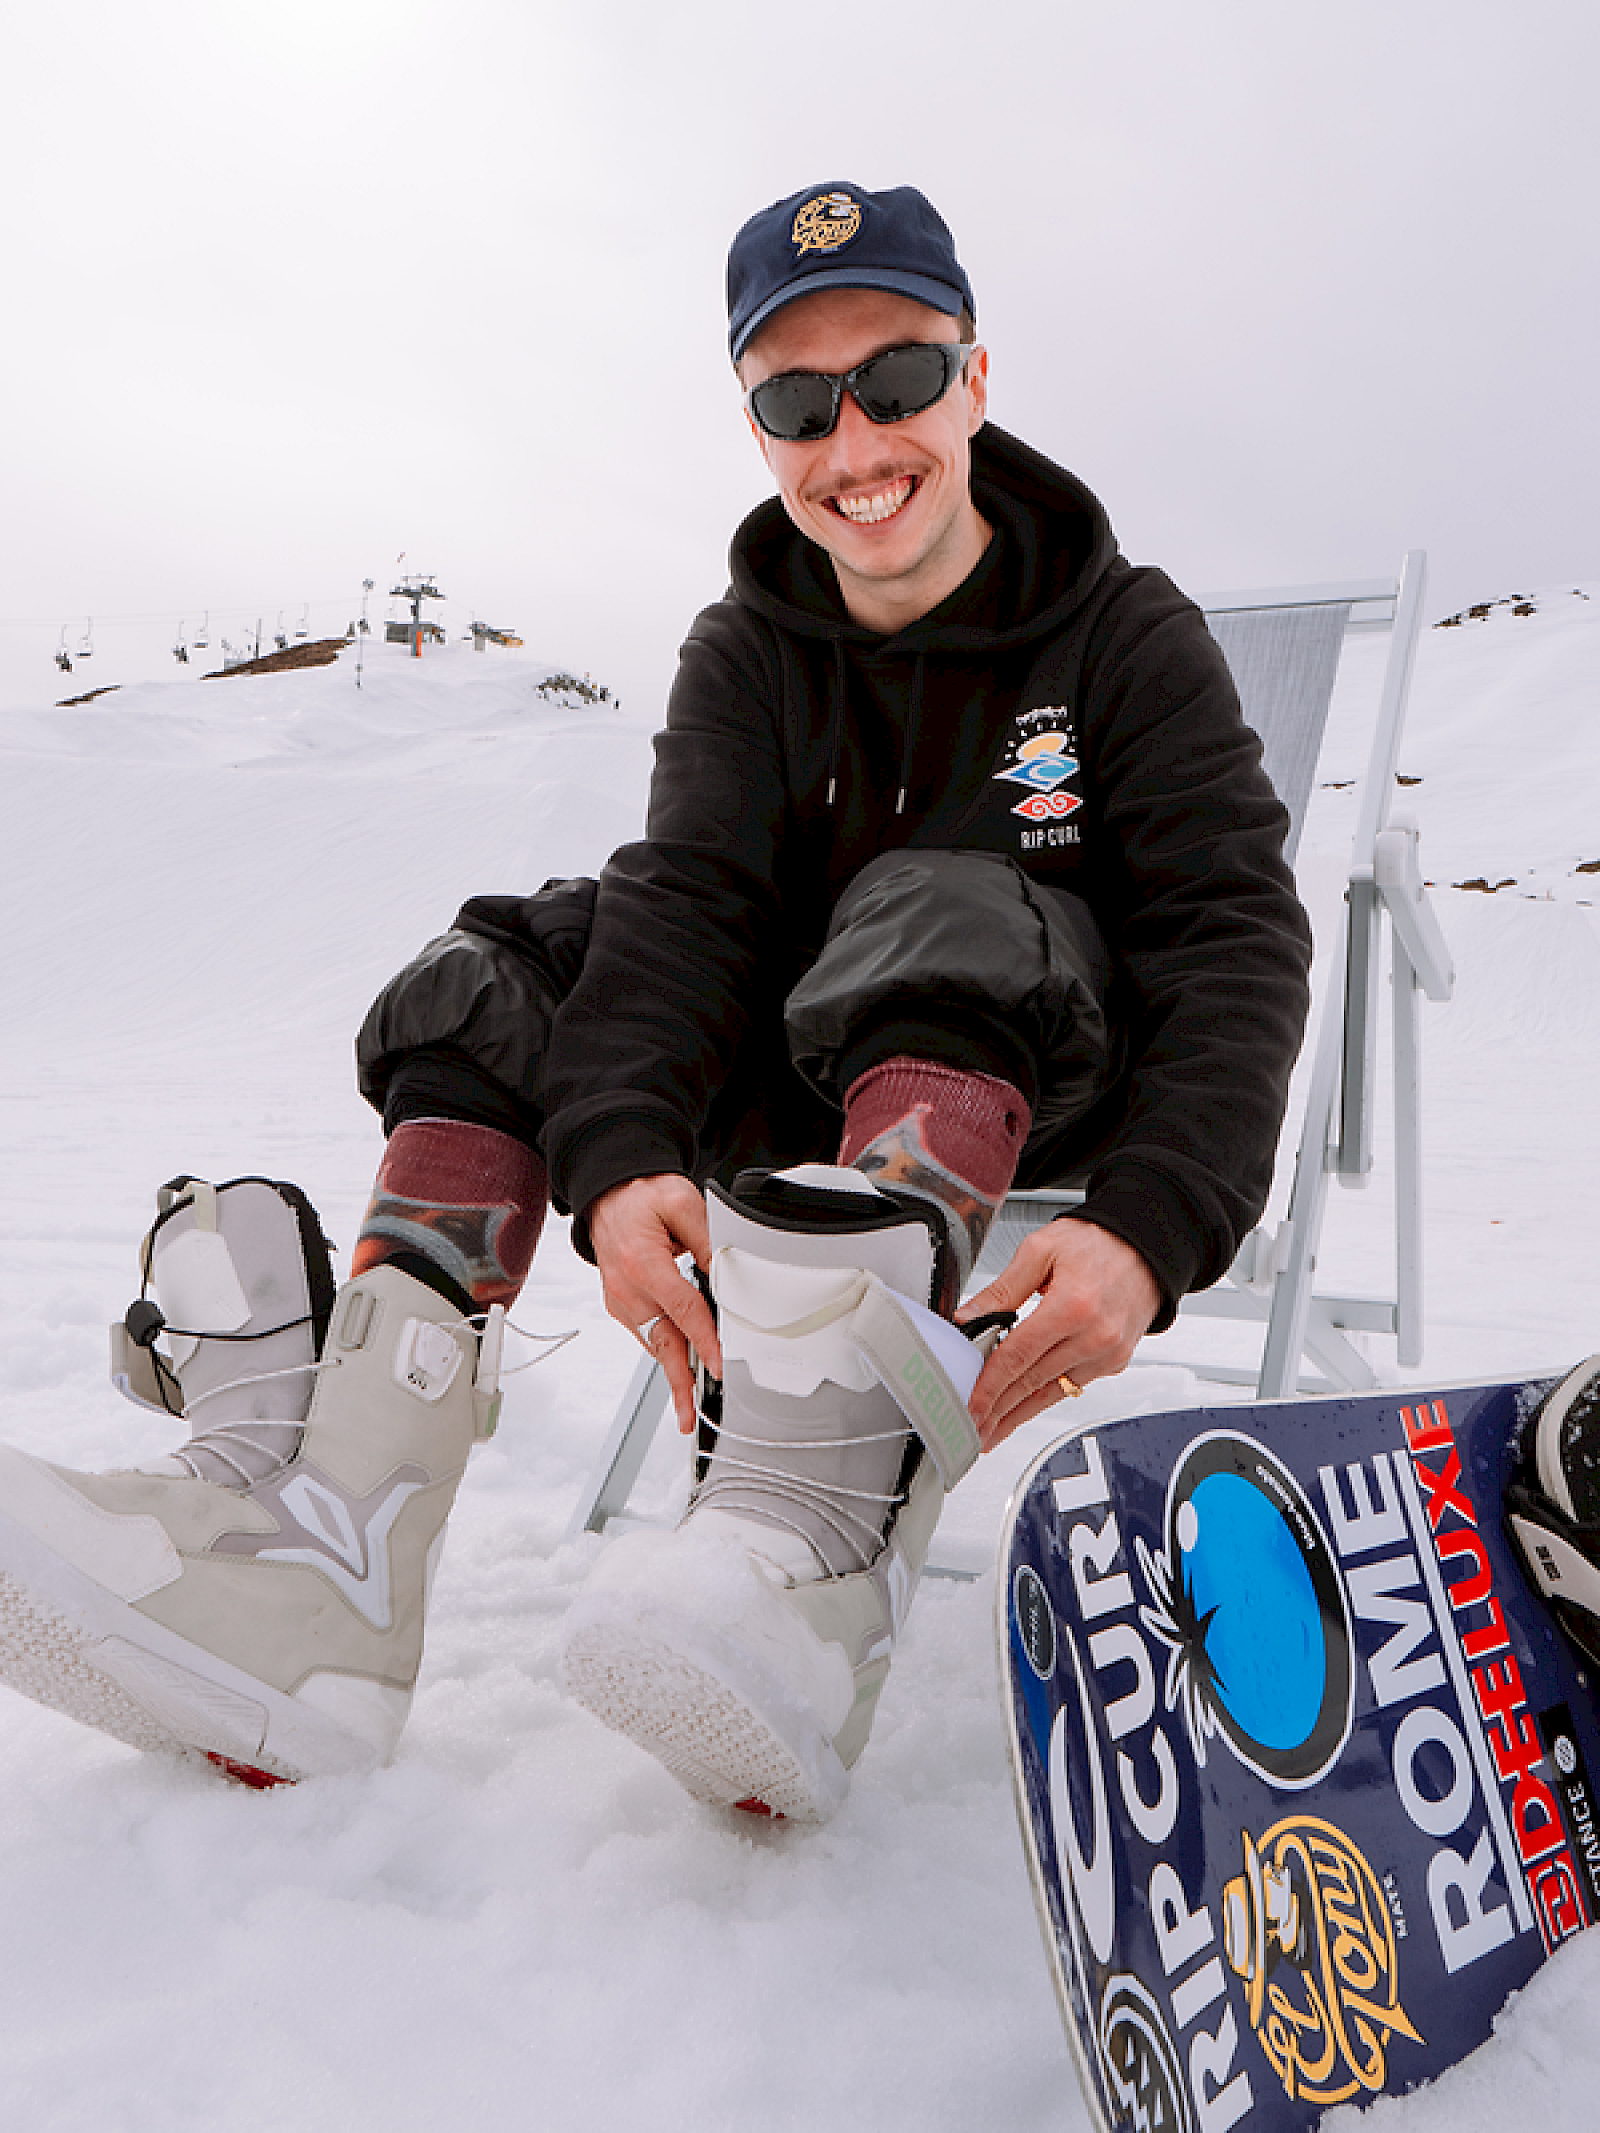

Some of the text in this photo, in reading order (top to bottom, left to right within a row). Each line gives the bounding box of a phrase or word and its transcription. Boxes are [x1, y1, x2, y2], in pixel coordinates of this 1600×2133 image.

[1020, 824, 1081, 849] RIP CURL
[902, 1351, 966, 1461] DEELUXE
[1398, 1399, 1567, 1867] DEELUXE
[1051, 1434, 1255, 2133] RIP CURL
[1317, 1451, 1516, 1976] ROME
